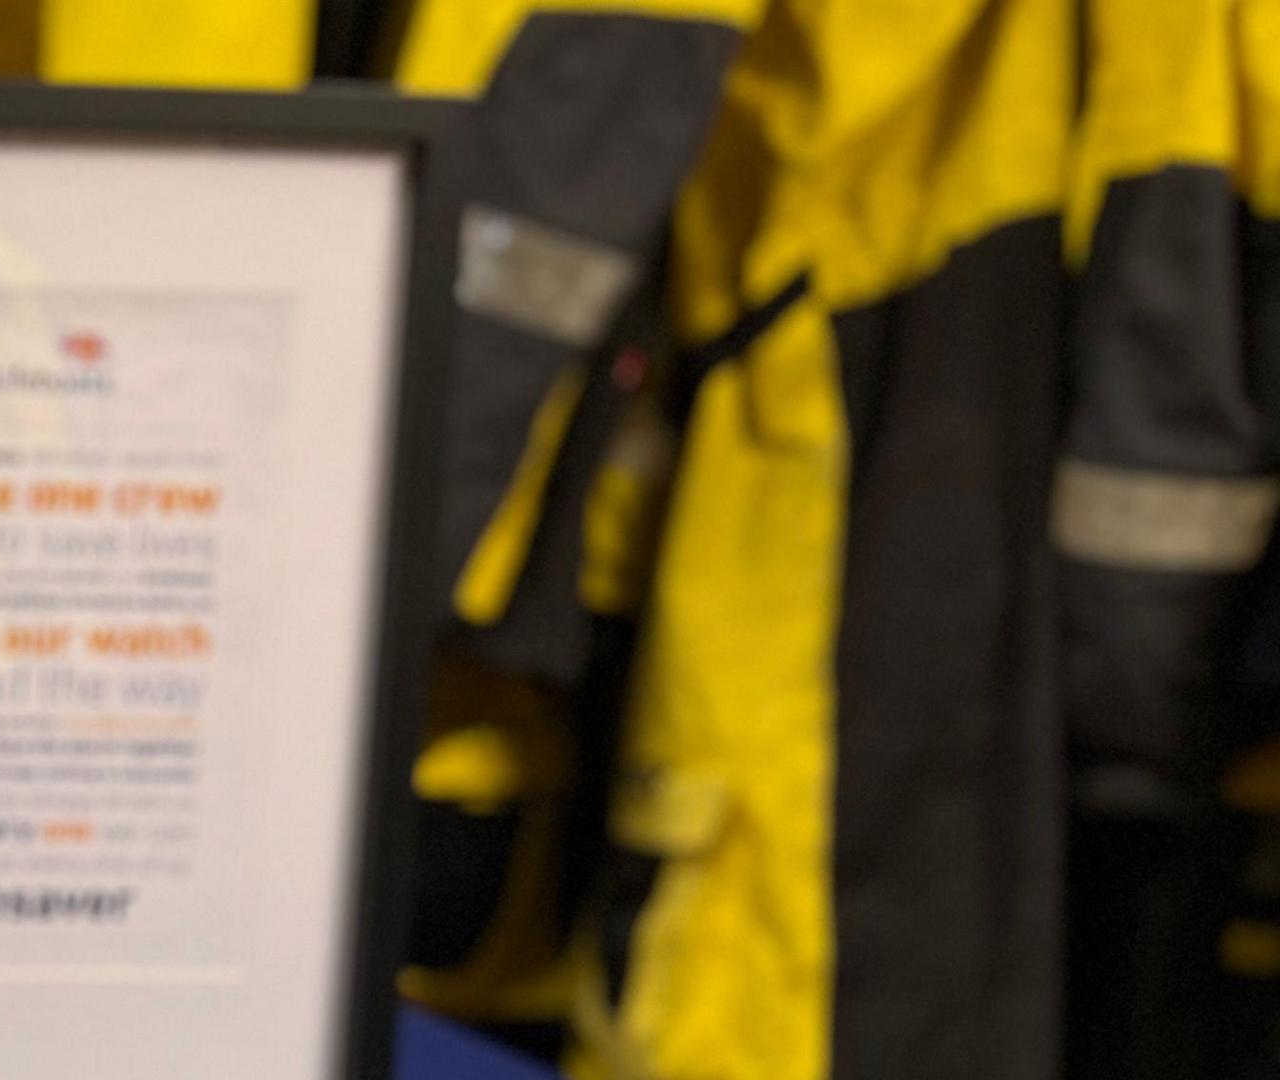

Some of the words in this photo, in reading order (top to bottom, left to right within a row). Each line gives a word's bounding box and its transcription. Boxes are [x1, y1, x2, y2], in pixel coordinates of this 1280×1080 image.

[28, 480, 100, 513] one
[114, 480, 220, 514] crew
[4, 624, 70, 654] our
[86, 622, 214, 657] watch
[41, 667, 103, 702] the
[121, 675, 205, 709] way
